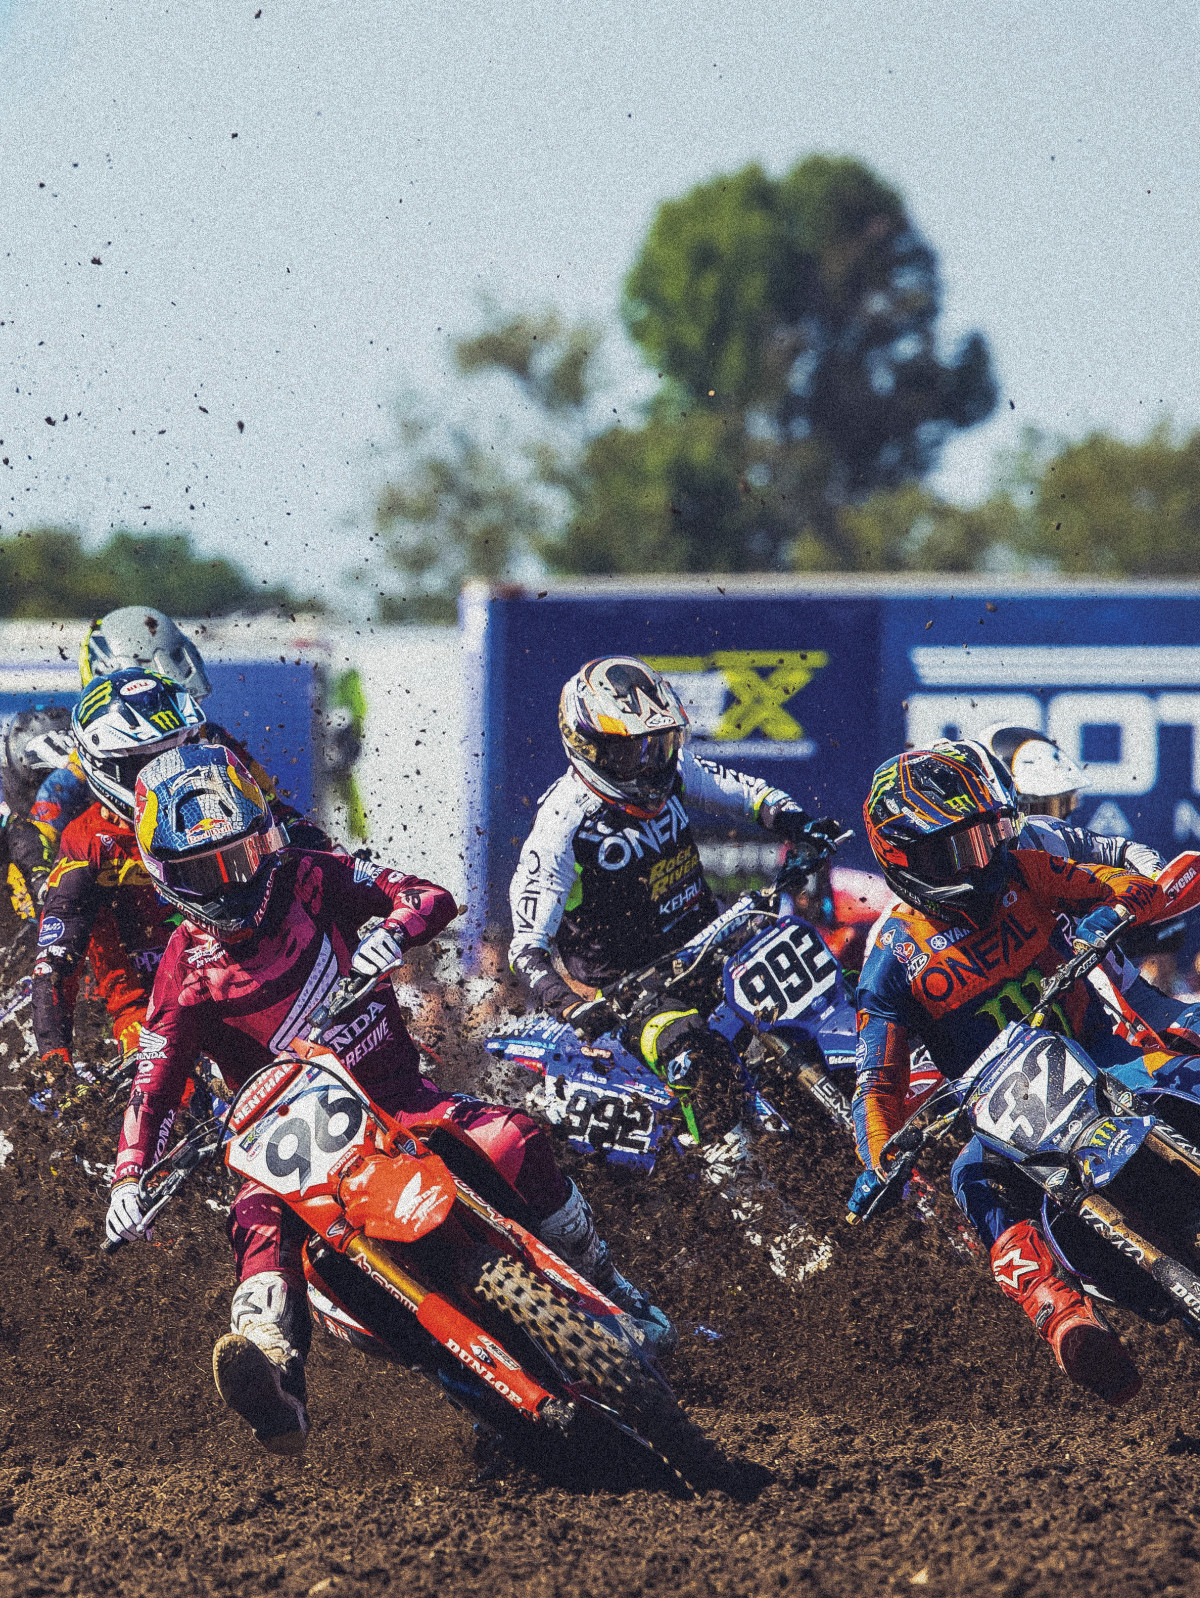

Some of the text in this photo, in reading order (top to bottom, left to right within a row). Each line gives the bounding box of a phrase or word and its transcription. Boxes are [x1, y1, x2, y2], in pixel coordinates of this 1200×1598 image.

[739, 924, 838, 1022] 992
[329, 1001, 387, 1054] NDA
[341, 1016, 389, 1069] RESSIVE
[989, 1037, 1089, 1150] 32
[266, 1089, 363, 1193] 96
[329, 1147, 358, 1176] HONDA
[444, 1338, 523, 1405] DUNLOP
